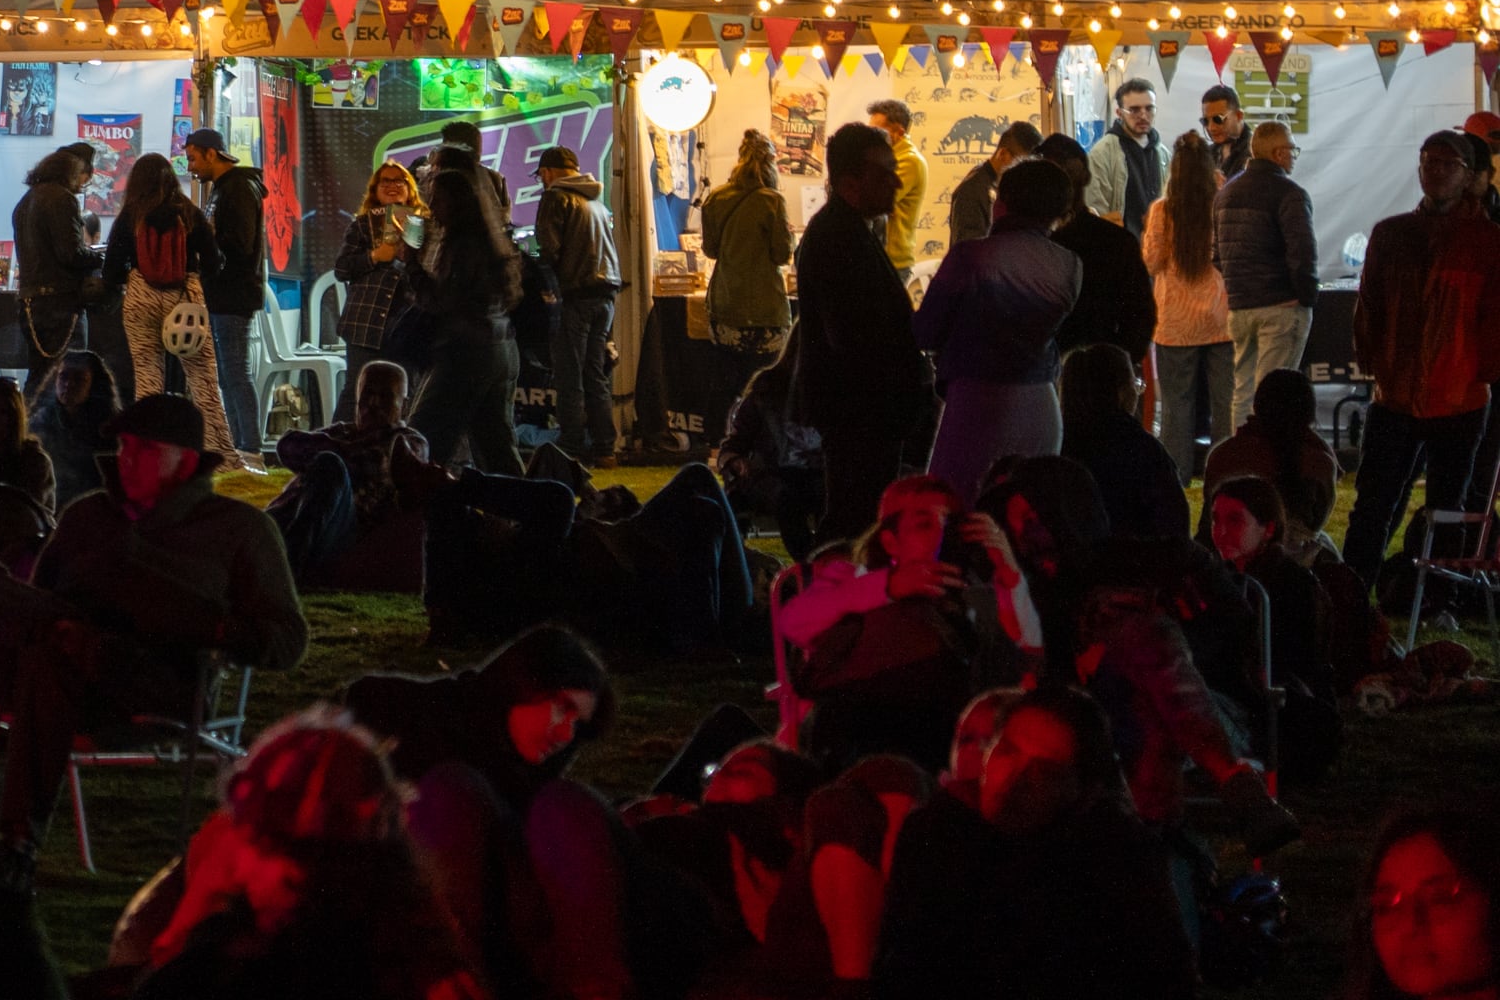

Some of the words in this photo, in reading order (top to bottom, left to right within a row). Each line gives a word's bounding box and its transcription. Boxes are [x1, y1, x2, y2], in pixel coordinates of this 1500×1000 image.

[332, 26, 381, 41] GEK
[84, 125, 134, 140] LIMBO
[782, 121, 814, 134] TINTAS
